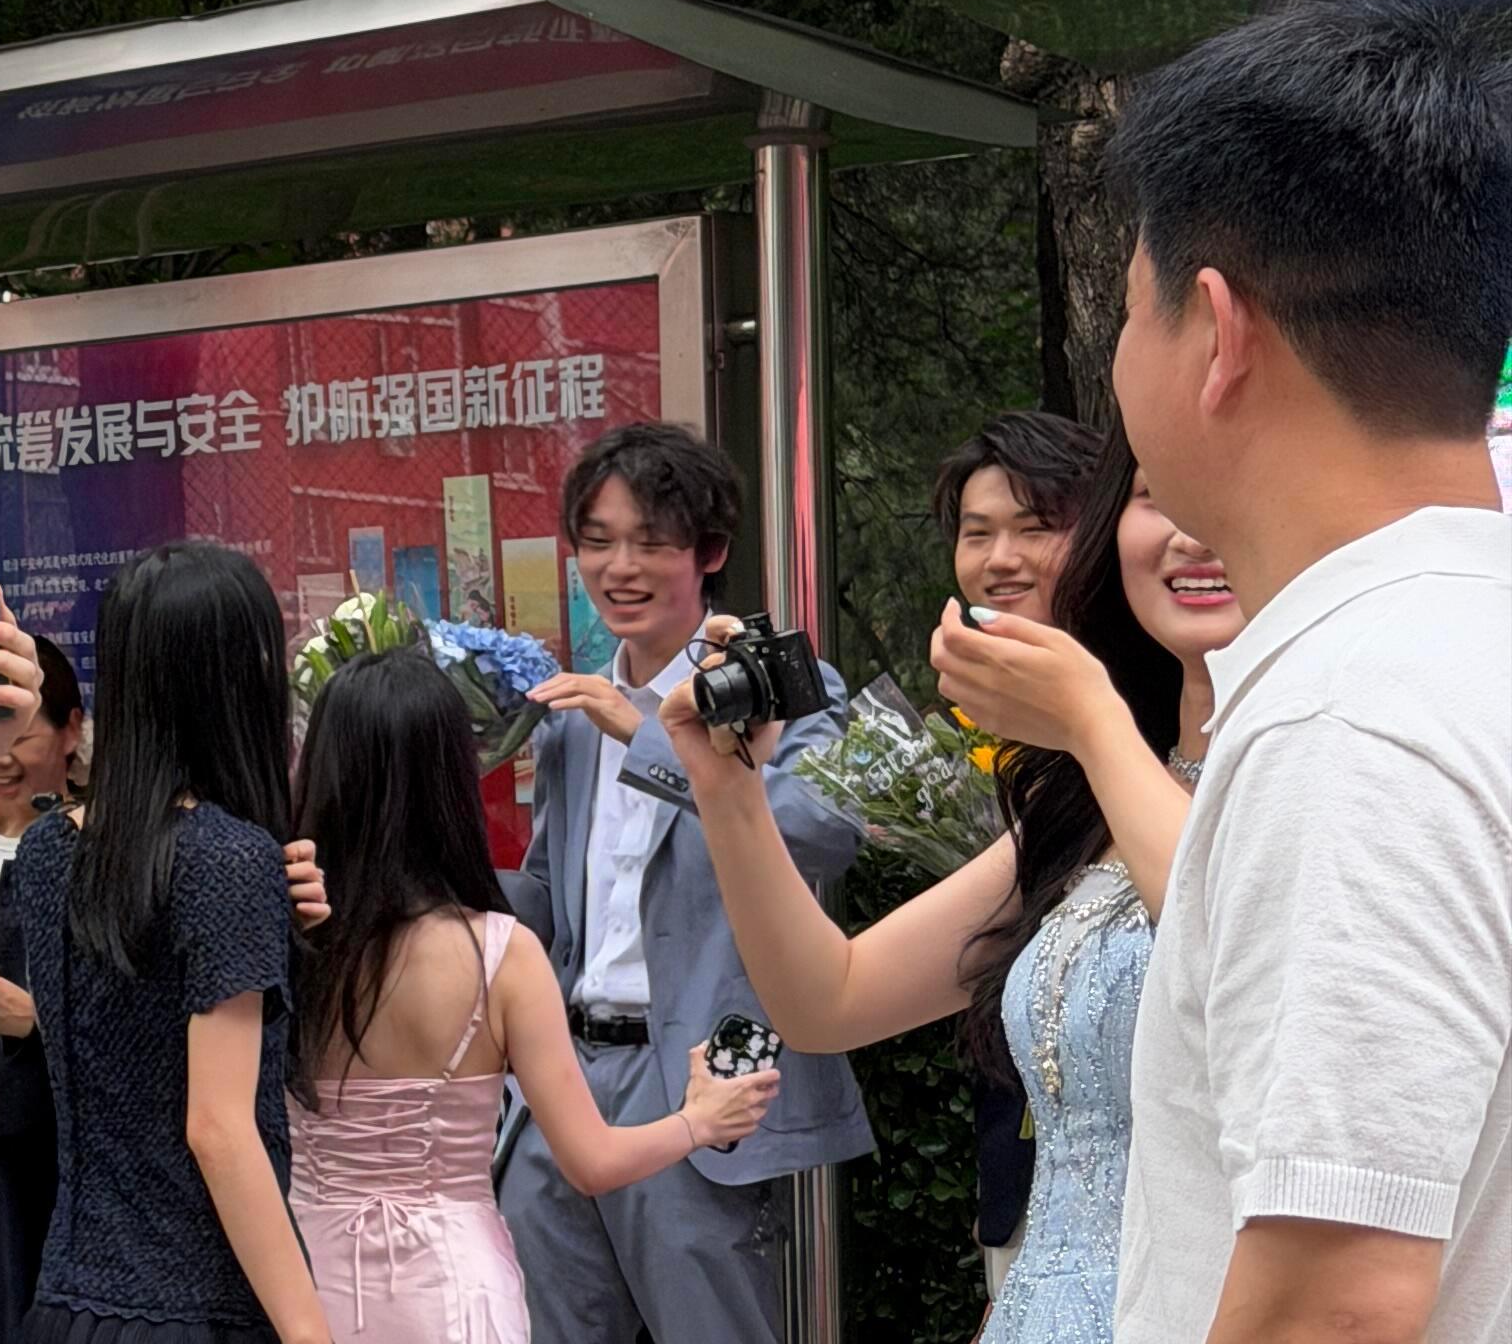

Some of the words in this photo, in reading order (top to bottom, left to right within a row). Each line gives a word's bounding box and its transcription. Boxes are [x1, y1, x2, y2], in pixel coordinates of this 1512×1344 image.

[283, 354, 605, 446] 护航强国新征程
